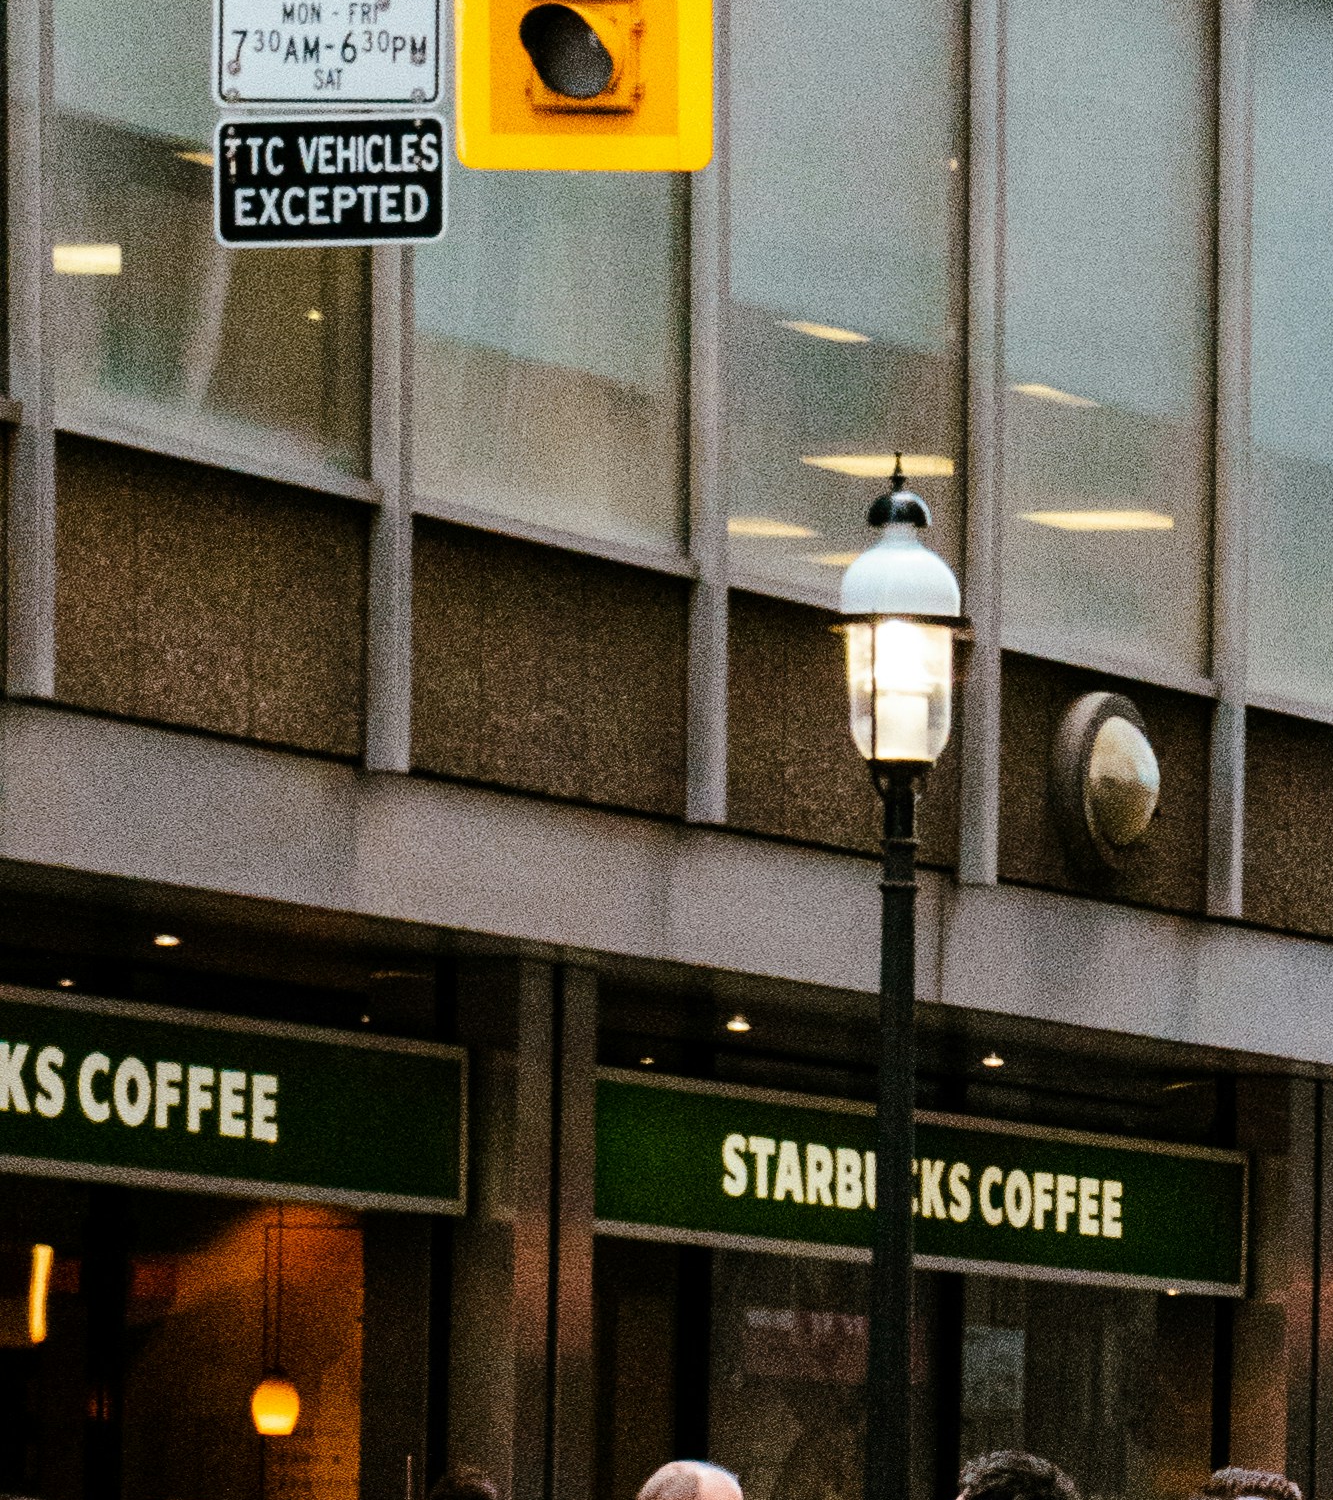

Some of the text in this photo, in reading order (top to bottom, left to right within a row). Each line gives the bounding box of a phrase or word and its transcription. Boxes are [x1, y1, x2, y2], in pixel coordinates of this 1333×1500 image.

[281, 2, 322, 25] MON
[348, 2, 379, 25] FRI
[313, 68, 343, 91] SAT
[224, 133, 439, 176] TTC VEHICLES
[233, 184, 429, 227] EXCEPTED
[77, 1050, 280, 1144] COFFEE
[720, 1132, 1124, 1239] STARBKS COFFEE
